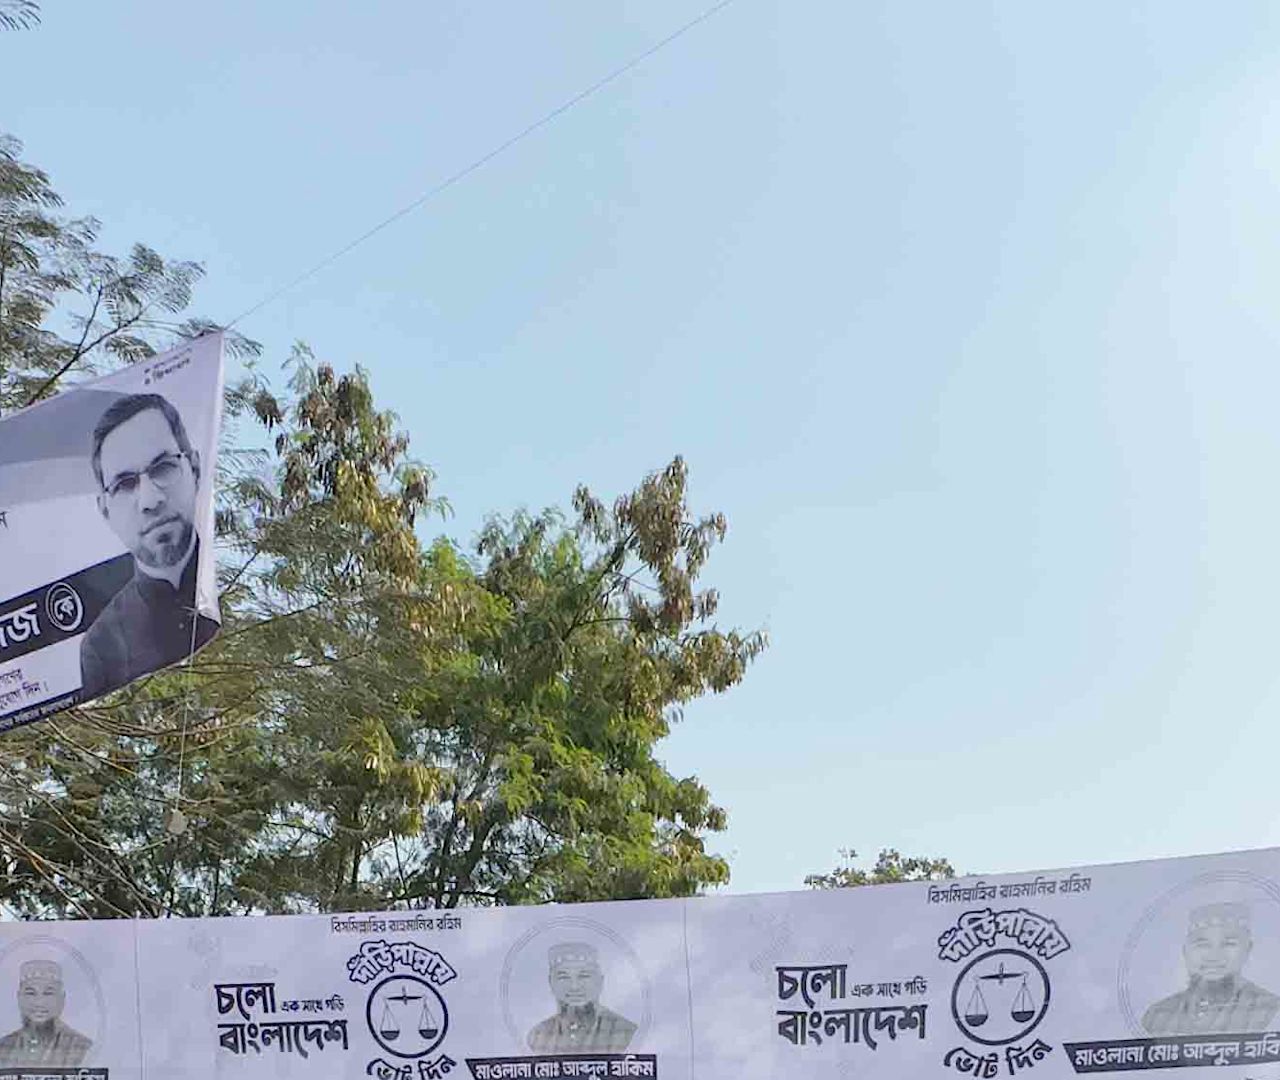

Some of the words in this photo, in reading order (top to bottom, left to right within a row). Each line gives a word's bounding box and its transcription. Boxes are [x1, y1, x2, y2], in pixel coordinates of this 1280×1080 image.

[938, 907, 1072, 962] দাঁড়িপাল্লায়
[346, 938, 458, 987] দাঁড়িপাল্লায়
[214, 982, 276, 1021] চলো
[775, 964, 848, 1009] চলো
[217, 1018, 349, 1059] বাংলাদেশ
[776, 1003, 929, 1051] বাংলাদেশ
[475, 1060, 532, 1080] মাওলানা
[610, 1054, 655, 1078] হাকিম
[944, 1046, 999, 1080] ভোট
[1005, 1038, 1053, 1076] দিন
[1075, 1044, 1144, 1068] মাওলানা
[1183, 1040, 1240, 1066] আব্দুল
